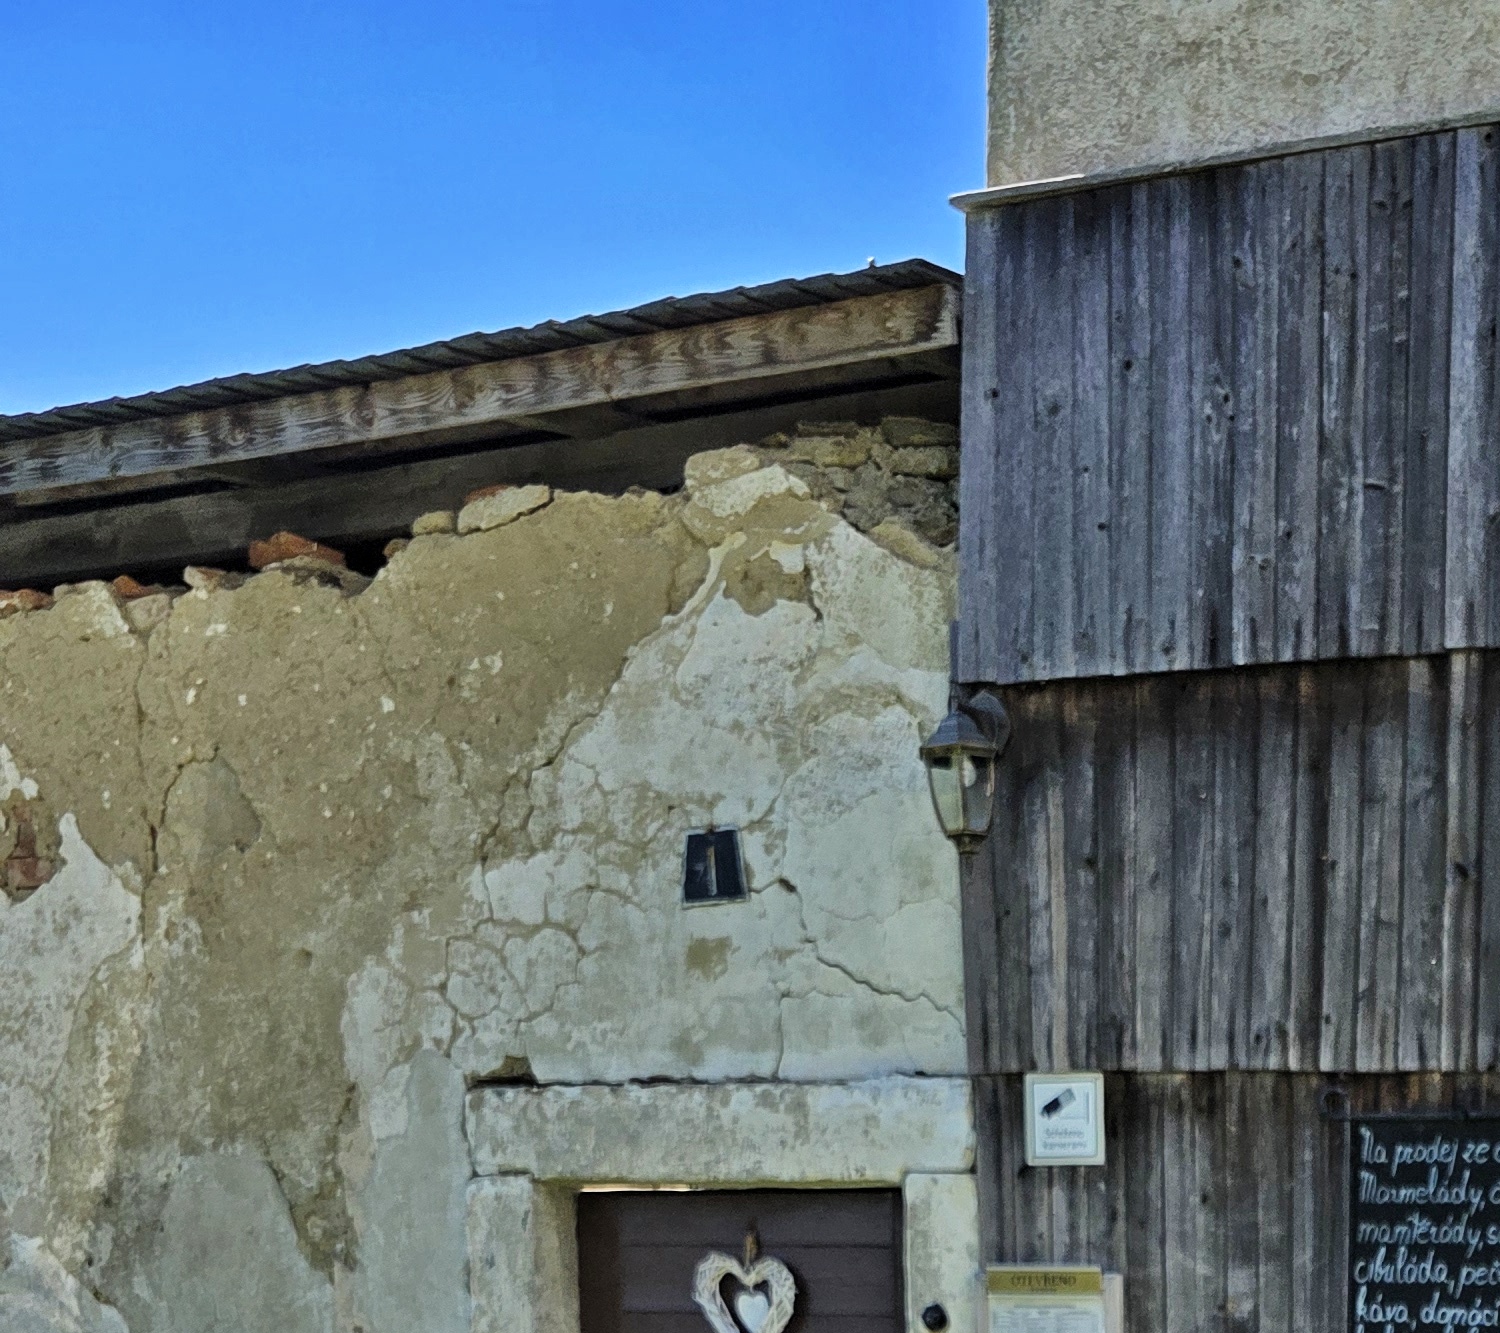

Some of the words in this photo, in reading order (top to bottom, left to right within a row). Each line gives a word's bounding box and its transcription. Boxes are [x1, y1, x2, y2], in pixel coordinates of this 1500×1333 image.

[1359, 1124, 1388, 1163] Na
[1392, 1134, 1459, 1177] prodej
[1462, 1140, 1490, 1164] ze
[1359, 1165, 1485, 1216] Marmelády,
[1355, 1285, 1416, 1331] káva,
